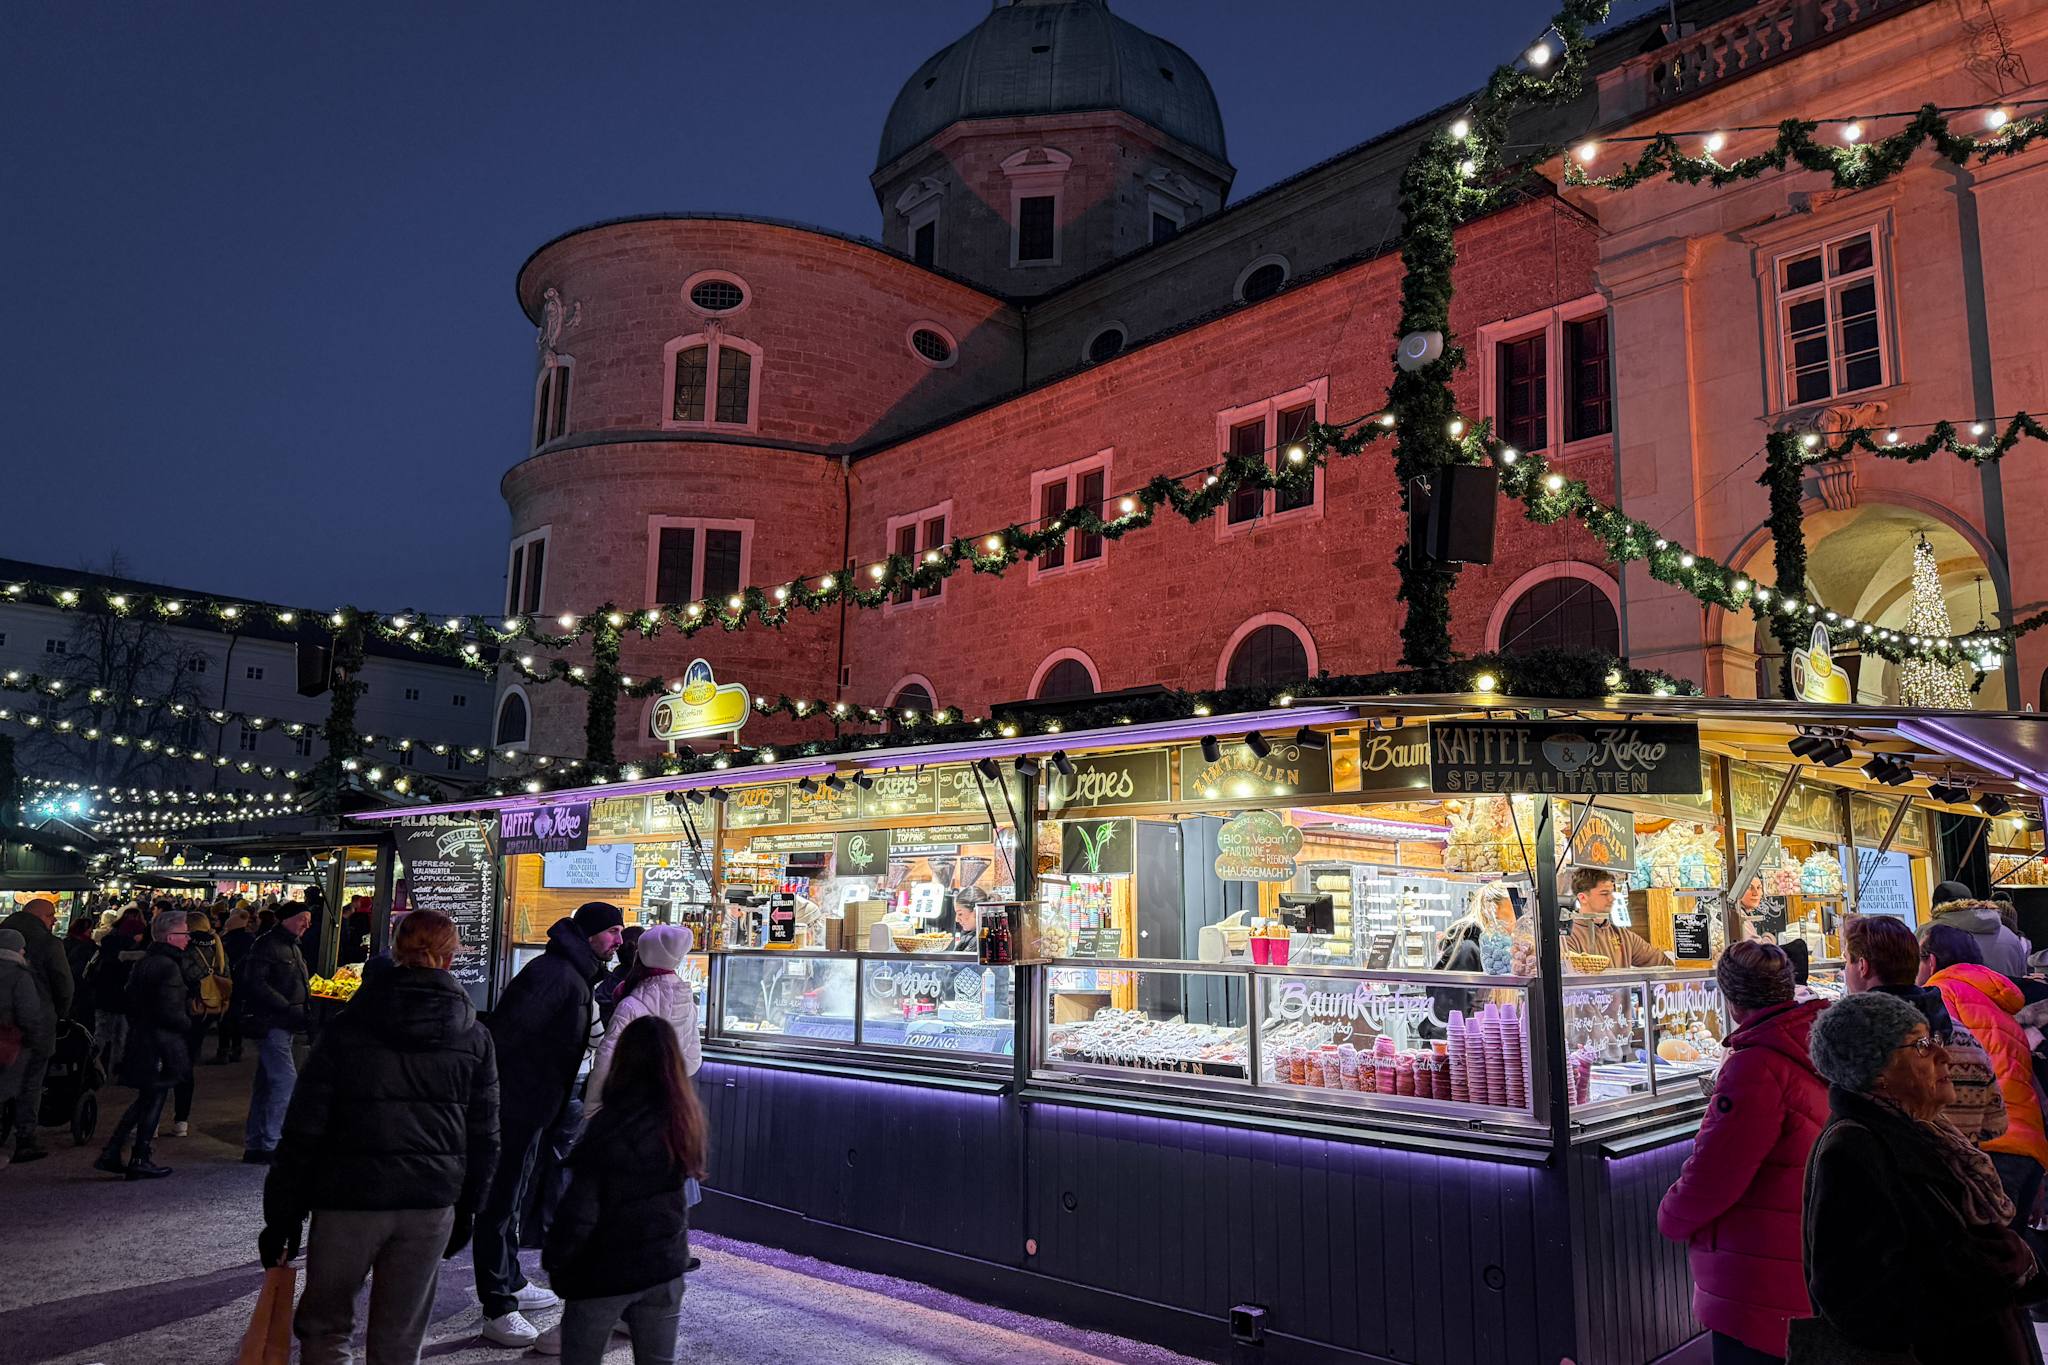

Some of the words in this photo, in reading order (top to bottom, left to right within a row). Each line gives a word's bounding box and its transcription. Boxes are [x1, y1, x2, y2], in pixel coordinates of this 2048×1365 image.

[657, 709, 671, 727] 77
[1435, 728, 1532, 765] KAFFEE
[1562, 747, 1576, 762] &
[1592, 728, 1666, 771] Kakao
[1192, 755, 1300, 794] ZIMTROLLEN
[1446, 767, 1648, 793] SPEZIALITÄTEN
[1055, 763, 1134, 806] Crêpes
[501, 812, 534, 838] KAFFEE
[549, 807, 581, 838] Kakao
[407, 826, 436, 841] und
[441, 830, 479, 845] NEUES
[1223, 834, 1242, 844] BIO
[1225, 847, 1265, 858] FAIRTRADE
[1223, 866, 1290, 878] HAUSGEMACHT
[1651, 982, 1722, 1022] Baumkuchen
[904, 1034, 960, 1049] TOPPINGS
